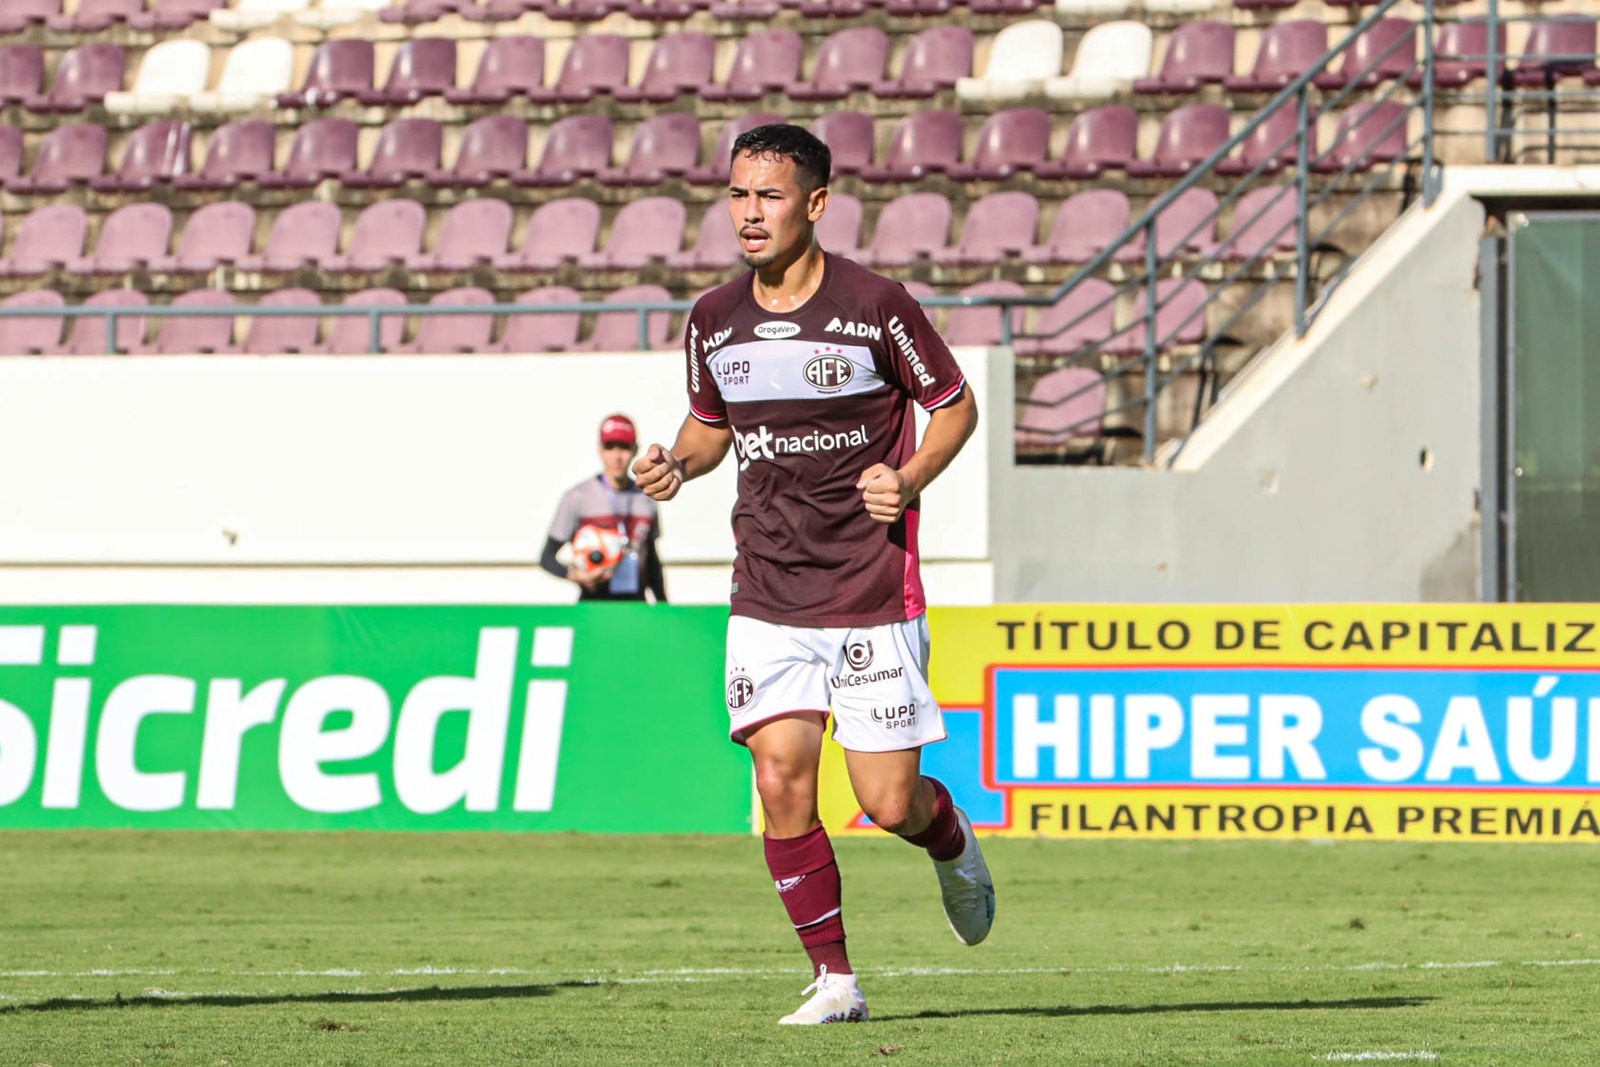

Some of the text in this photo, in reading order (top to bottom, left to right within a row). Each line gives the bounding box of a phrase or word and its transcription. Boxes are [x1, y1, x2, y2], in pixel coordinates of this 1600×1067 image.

[842, 321, 882, 341] ADN
[887, 315, 936, 388] Unimed
[716, 360, 751, 376] LUPO
[723, 375, 750, 386] SPORT
[806, 358, 849, 386] AFE
[997, 612, 1597, 652] TÍTULO DE CAPITALIZ
[831, 666, 904, 690] UniCesumar
[728, 677, 754, 708] AFE
[872, 703, 916, 721] LUPO
[886, 718, 917, 730] SPORT
[1012, 675, 1600, 784] HIPER SAÚ
[1030, 801, 1600, 836] FILANTROPIA PREMIÁ
